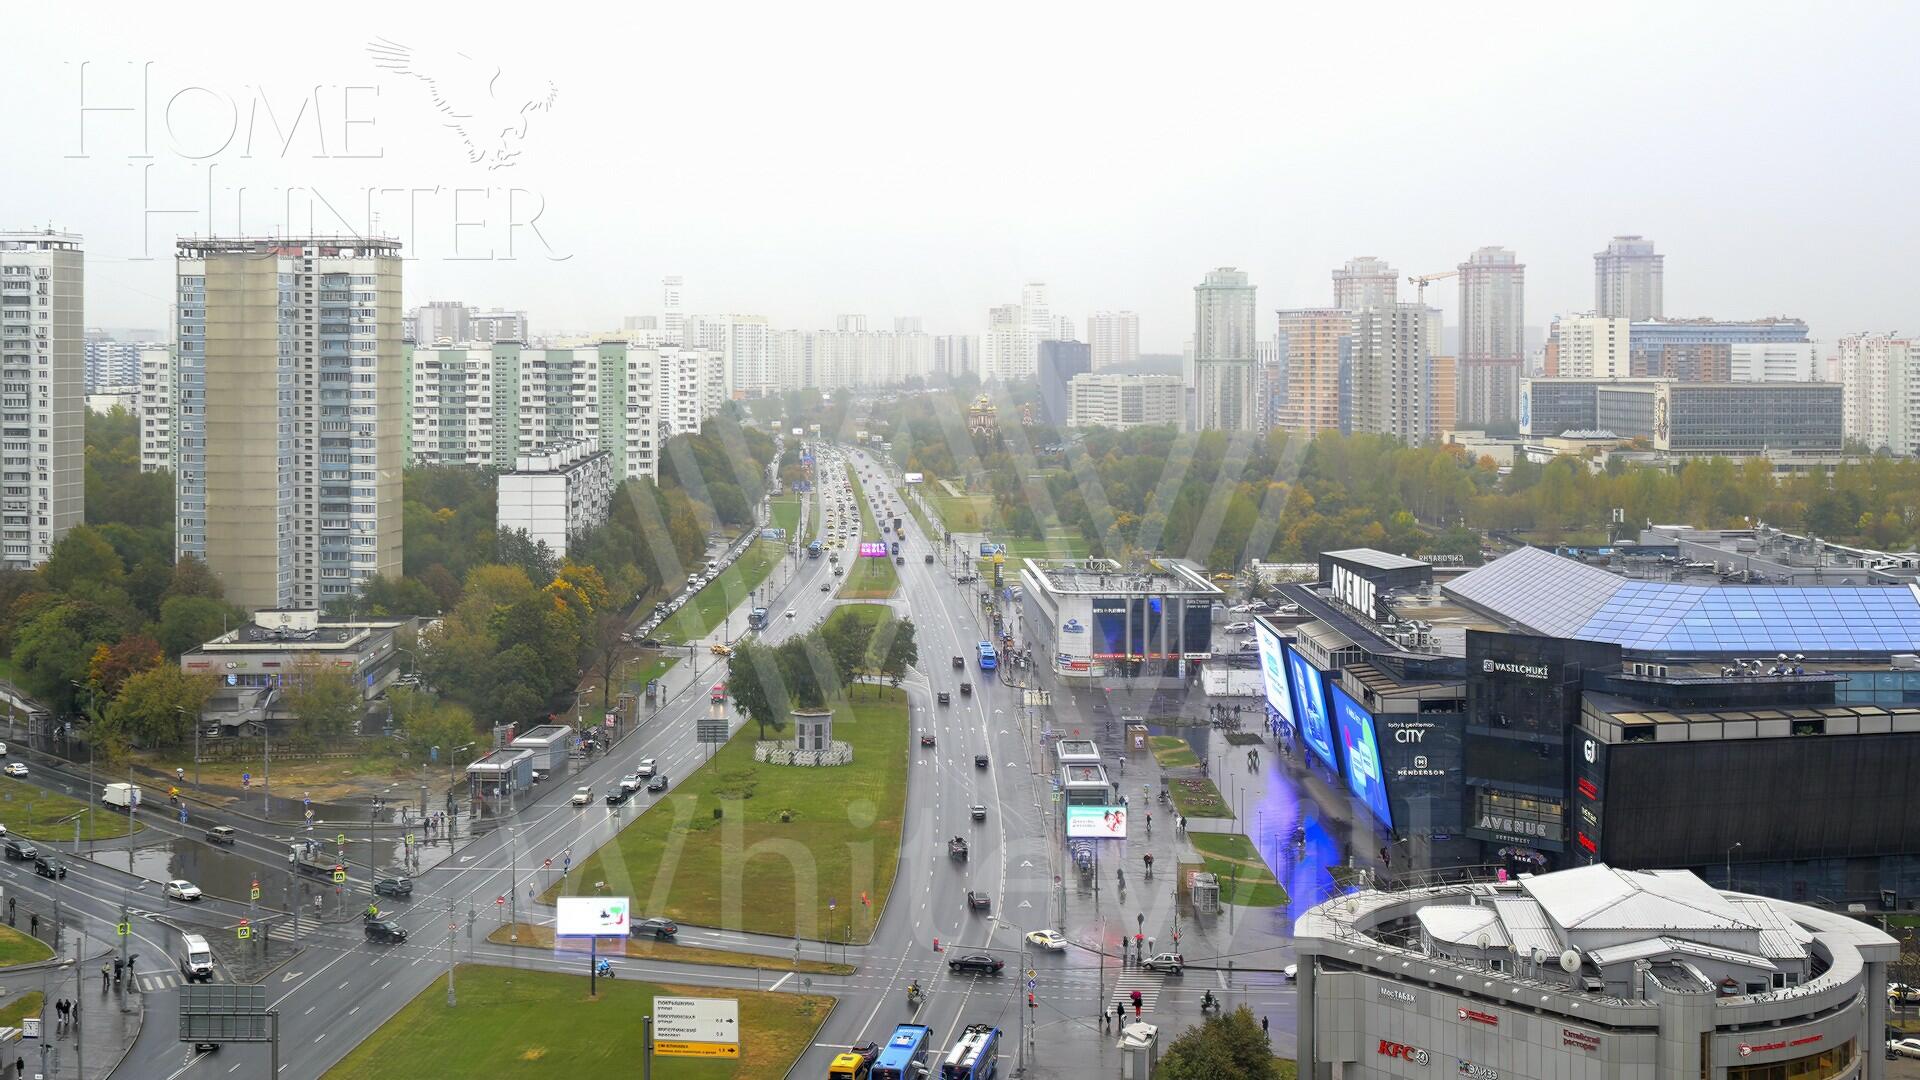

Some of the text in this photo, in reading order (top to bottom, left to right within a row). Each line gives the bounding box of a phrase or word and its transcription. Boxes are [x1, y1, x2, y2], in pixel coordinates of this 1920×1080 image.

[1332, 563, 1377, 621] AVENUE
[1395, 729, 1426, 743] CITY
[1480, 815, 1547, 837] AVENUE
[1378, 1039, 1416, 1062] KFC
